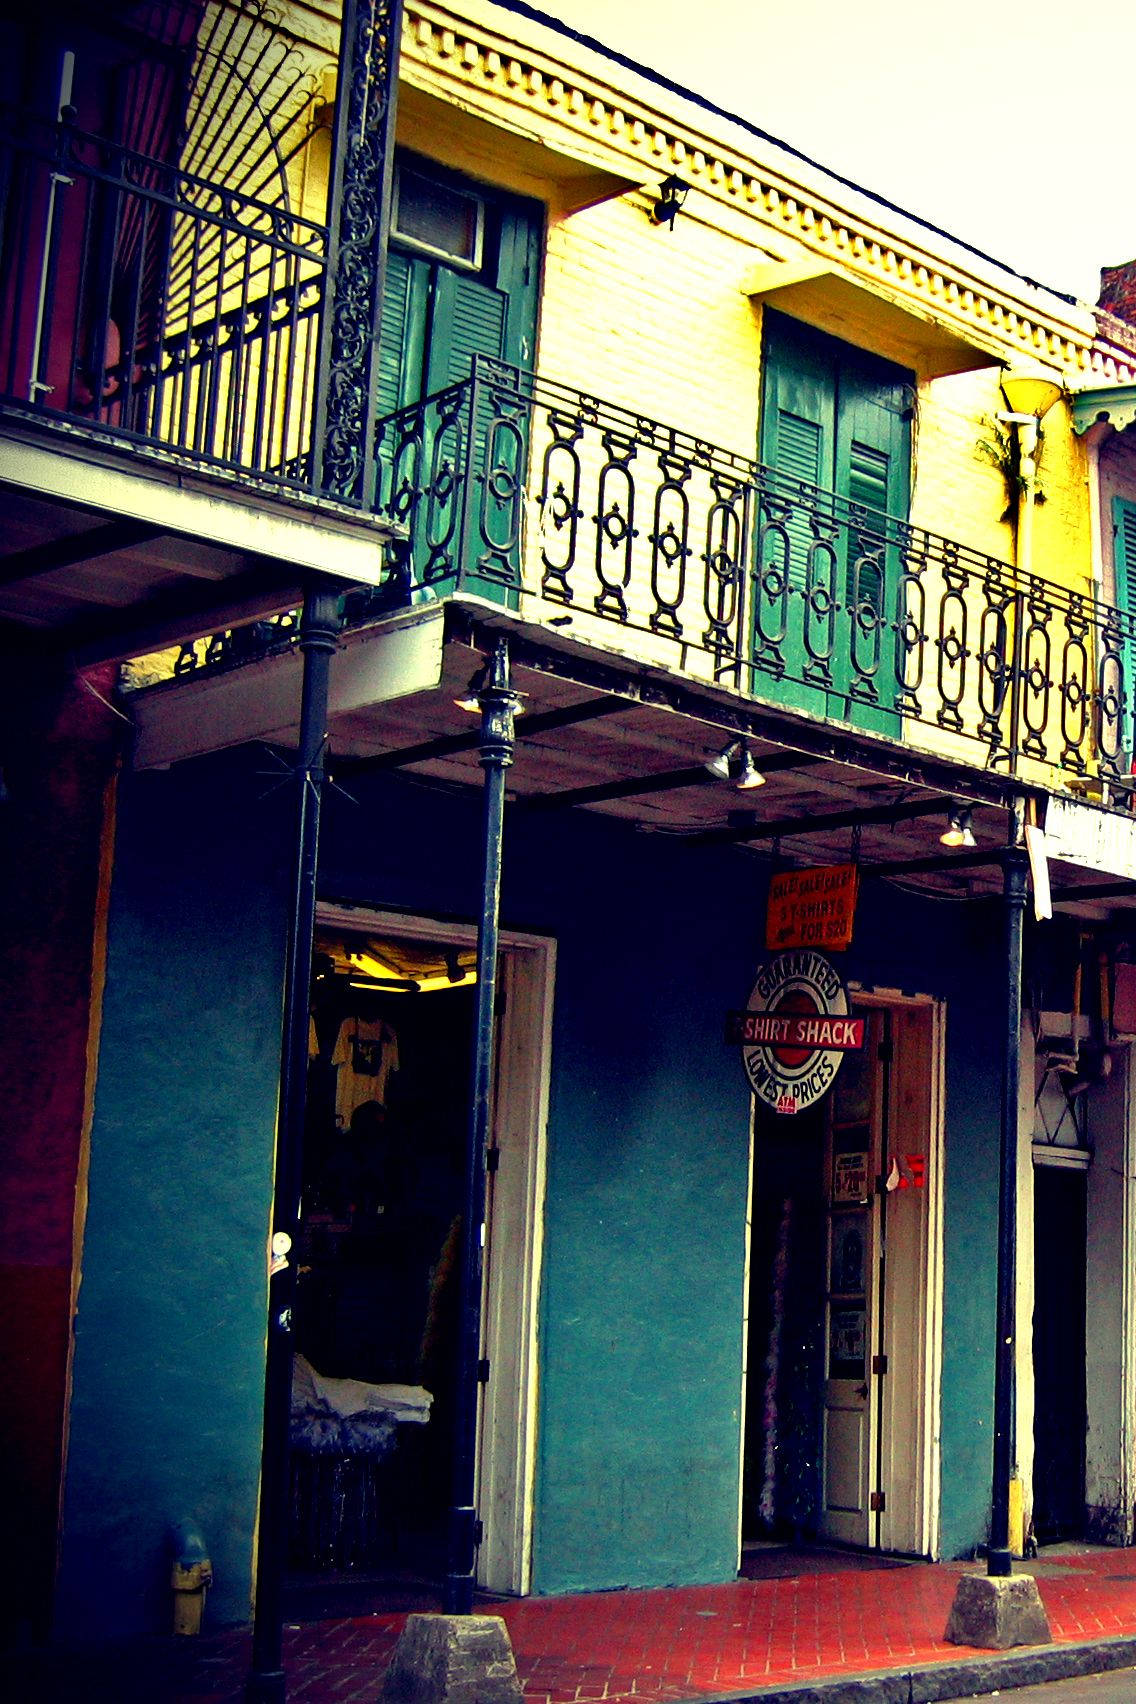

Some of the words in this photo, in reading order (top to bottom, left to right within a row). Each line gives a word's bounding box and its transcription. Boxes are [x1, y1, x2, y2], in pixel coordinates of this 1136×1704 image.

[790, 897, 844, 920] T-SHIRTS
[800, 922, 823, 941] FOR
[757, 952, 840, 999] GUARANTEED
[796, 1020, 857, 1045] SHACK
[747, 1049, 789, 1102] LOWEST
[792, 1055, 835, 1104] PRICES
[778, 1096, 796, 1107] ATM
